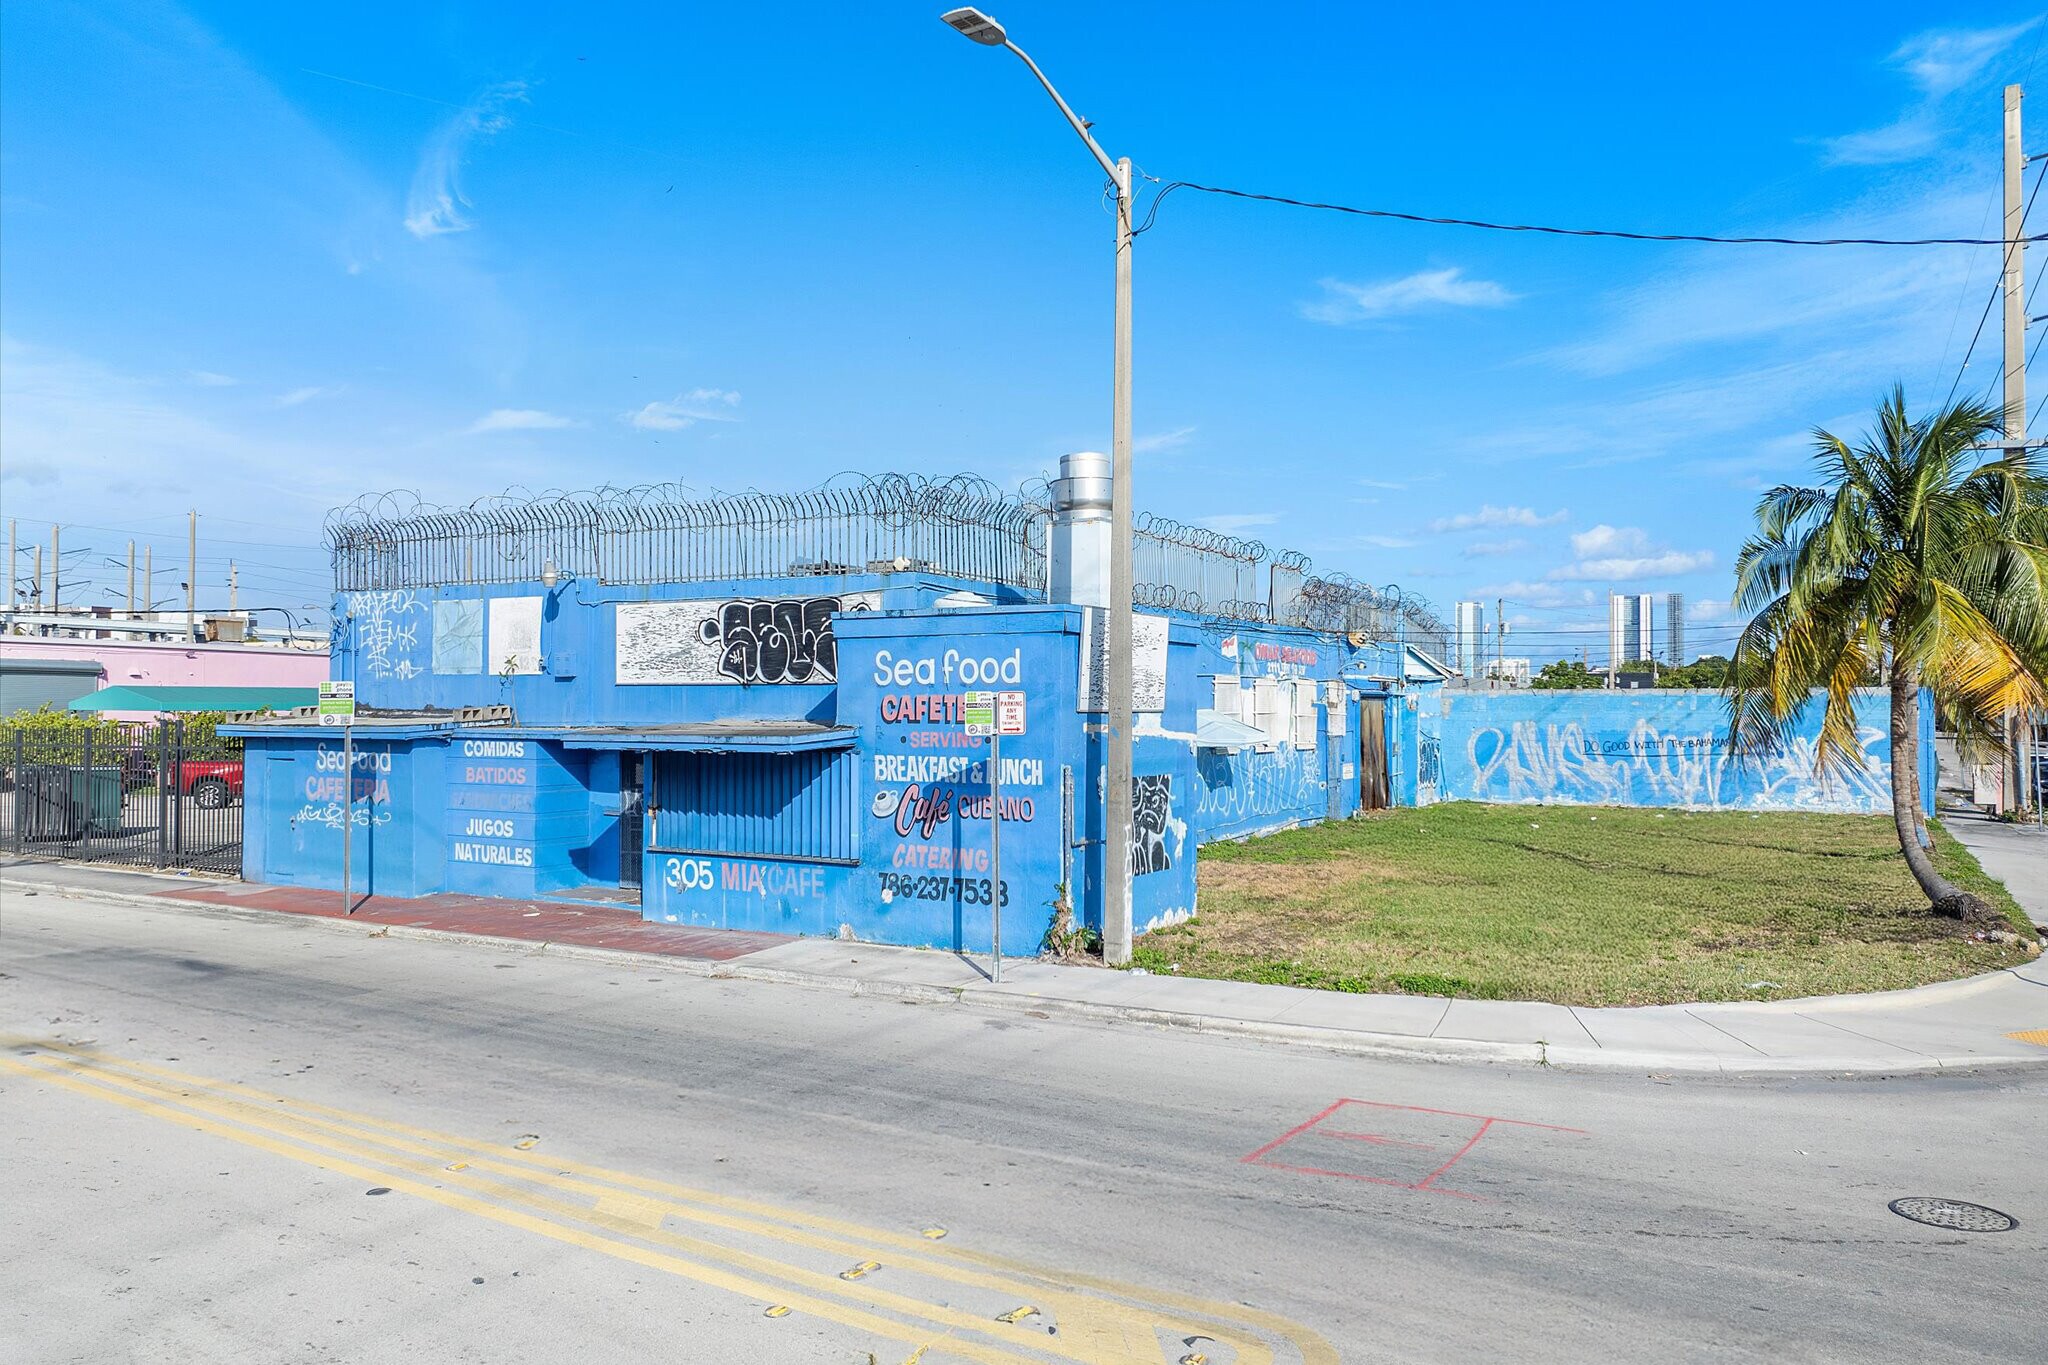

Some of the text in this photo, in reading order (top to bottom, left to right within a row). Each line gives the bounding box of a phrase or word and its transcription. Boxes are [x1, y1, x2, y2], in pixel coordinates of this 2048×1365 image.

[874, 647, 1022, 686] Sea food
[881, 694, 965, 724] CAFETE
[464, 740, 525, 757] COMIDAS
[910, 731, 982, 749] SERVING
[1584, 740, 1600, 753] DO
[1602, 741, 1630, 753] GOOD
[1634, 739, 1664, 750] WITH
[1669, 740, 1686, 748] THE
[317, 742, 345, 772] Sea
[874, 755, 968, 783] BREAKFAST
[971, 762, 983, 783] &
[466, 767, 526, 784] BATIDOS
[305, 776, 391, 804] CAFEERIA
[895, 783, 1035, 840] Café CUBANO
[466, 818, 514, 837] JUGOS
[455, 842, 532, 867] NATURALES
[892, 843, 989, 873] CATERING
[666, 858, 714, 890] 305
